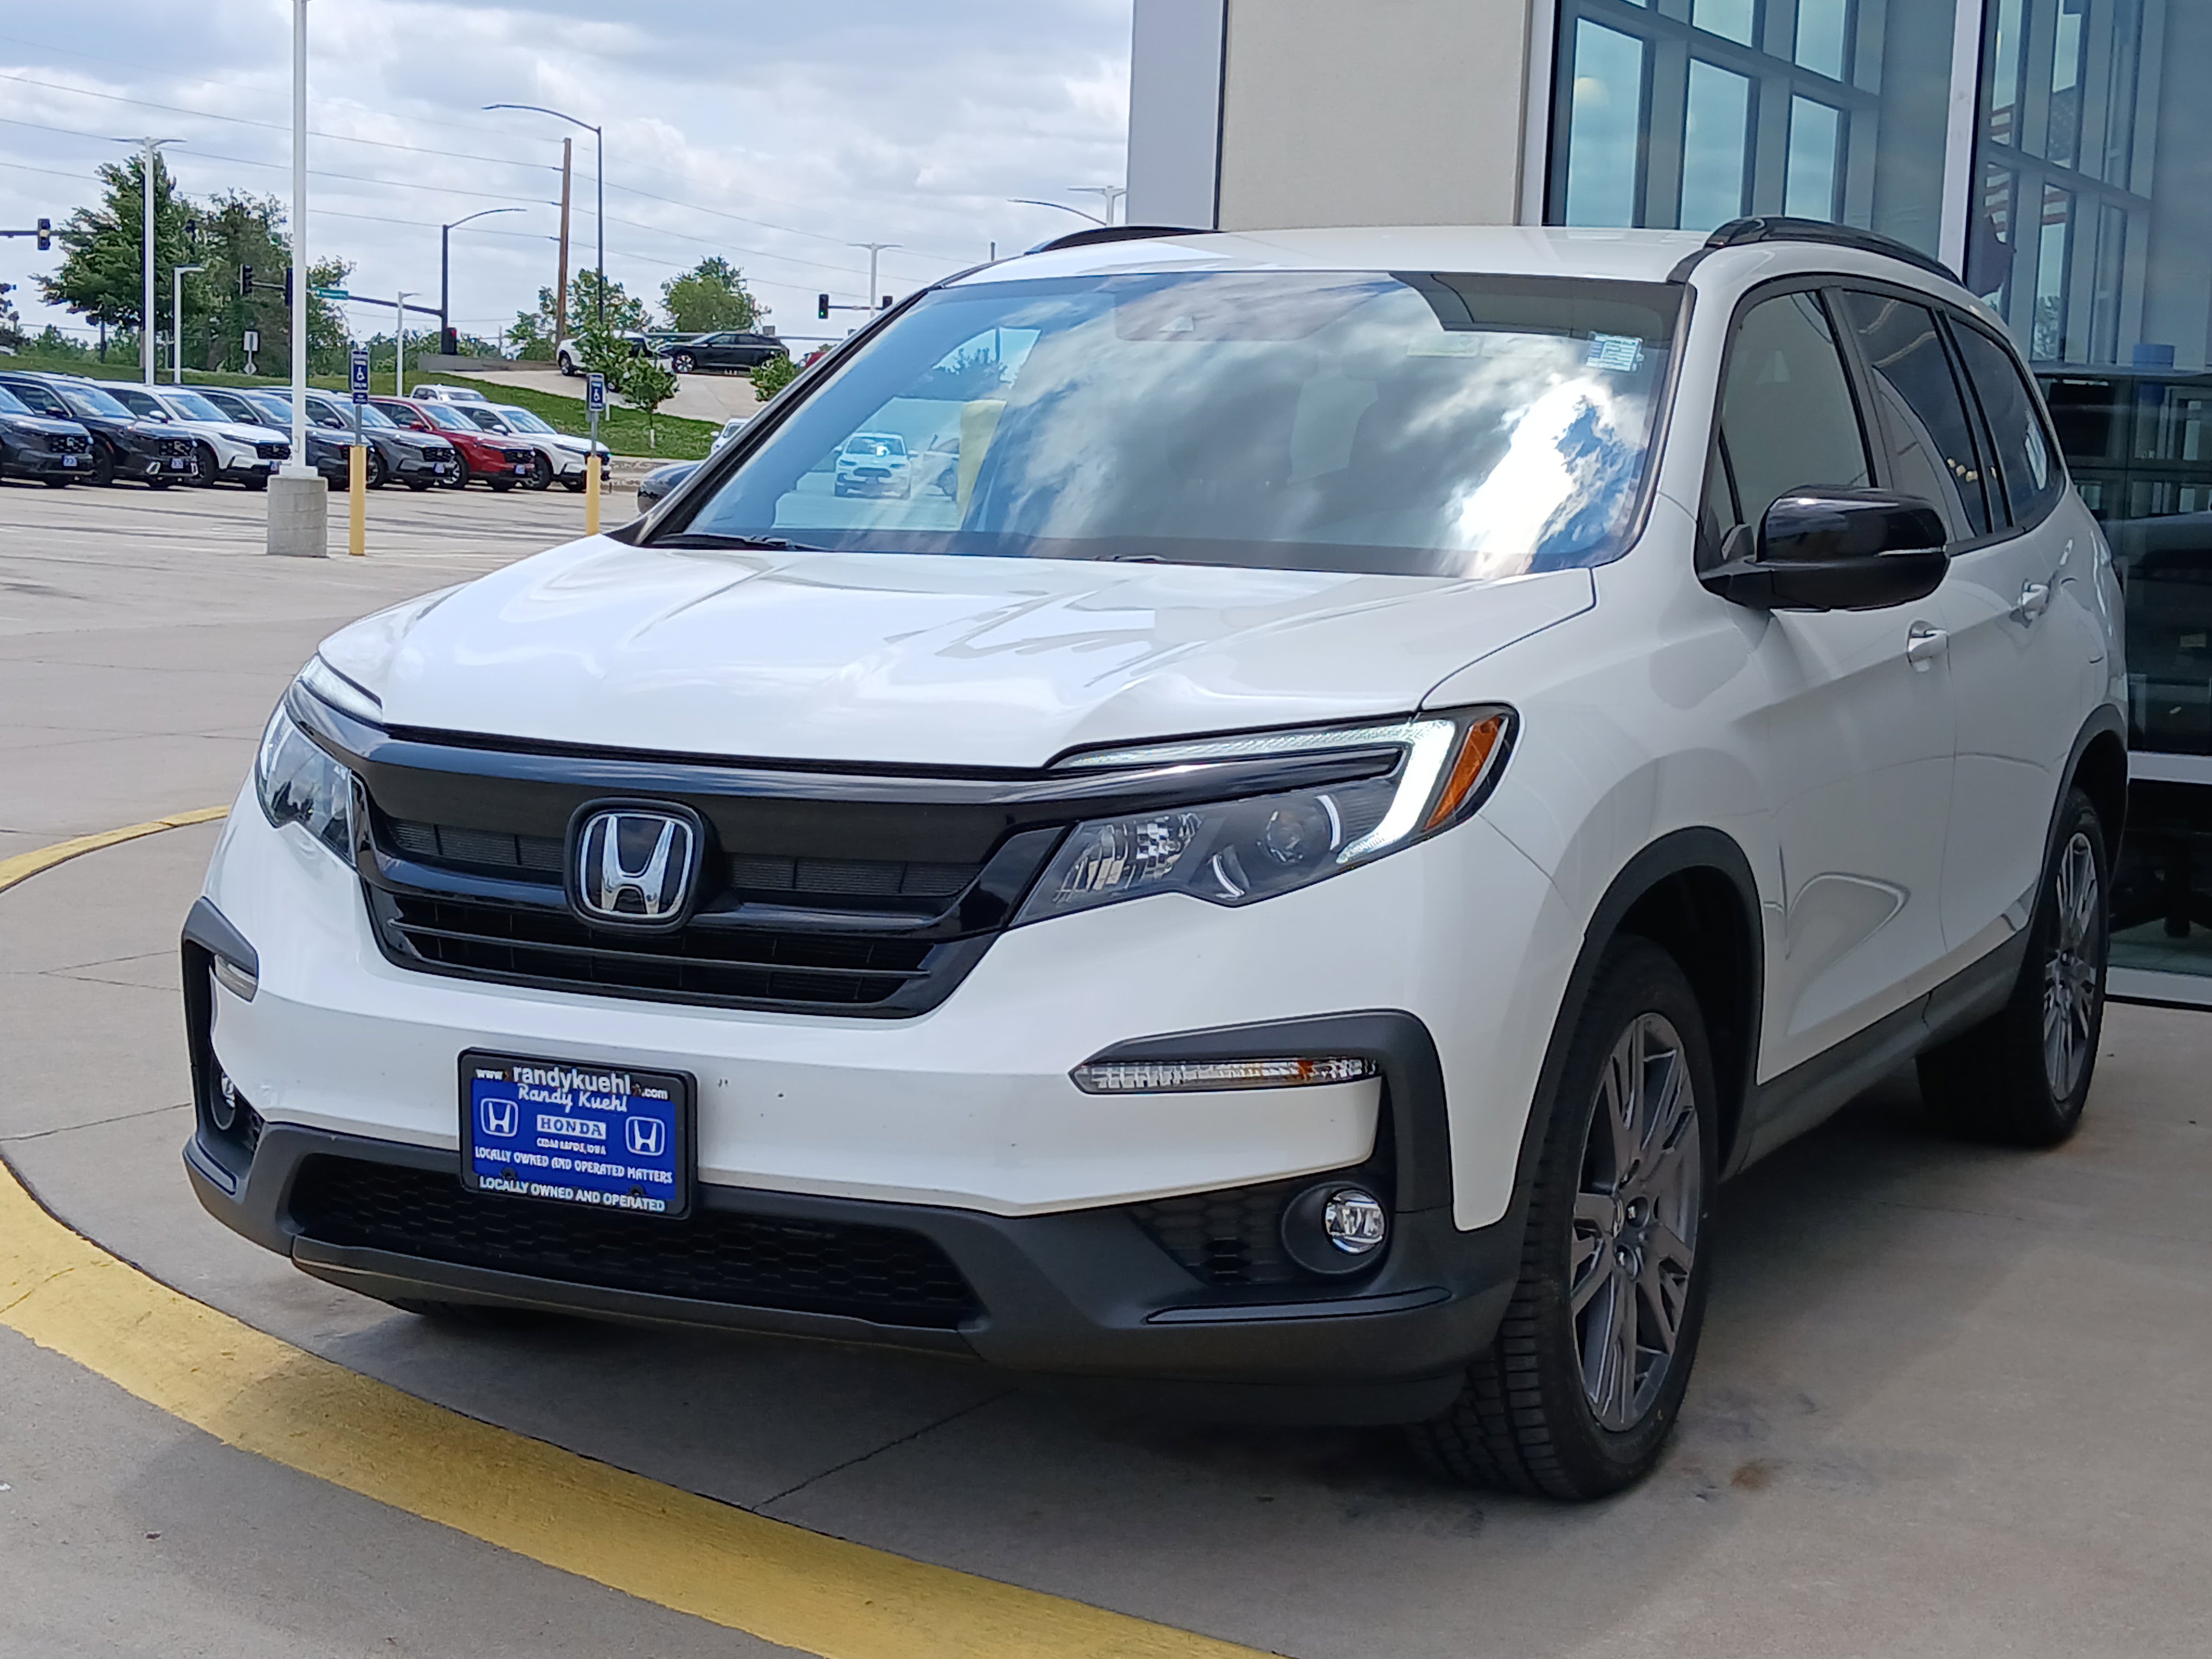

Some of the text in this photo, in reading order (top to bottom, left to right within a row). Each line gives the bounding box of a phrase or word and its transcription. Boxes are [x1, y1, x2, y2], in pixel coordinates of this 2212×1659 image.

[513, 1066, 631, 1095] randykuehl
[517, 1083, 627, 1113] Randy Kuehl
[541, 1117, 603, 1137] HONDA
[475, 1146, 673, 1184] LOCALLY OWNED AND OPERATED MATTERS
[479, 1175, 665, 1212] LOCALLY OWNED AND OPERATED
